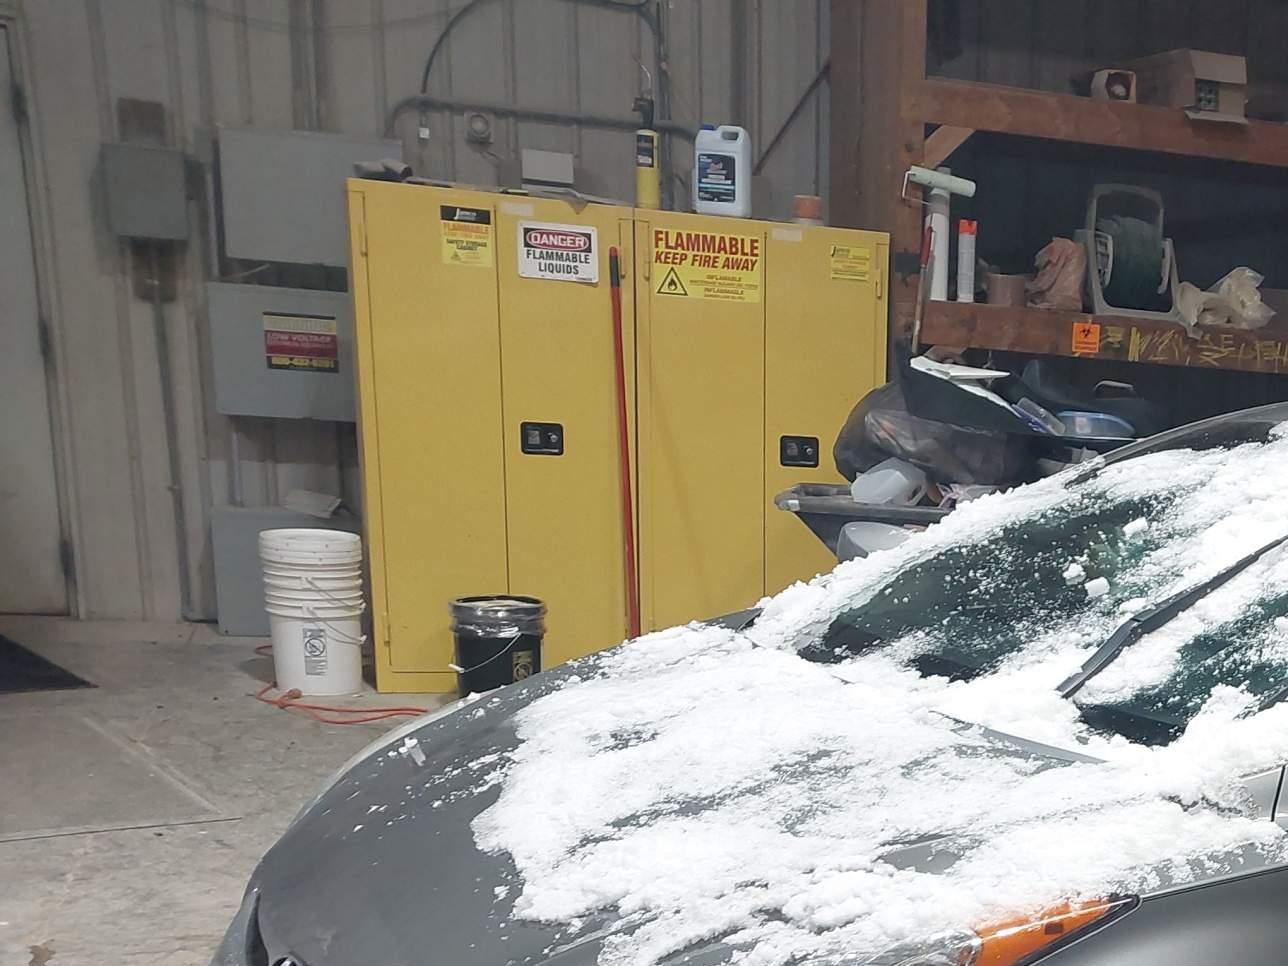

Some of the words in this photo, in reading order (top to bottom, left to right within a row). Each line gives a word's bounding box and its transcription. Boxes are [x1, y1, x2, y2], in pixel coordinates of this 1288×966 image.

[530, 232, 586, 249] DANGER
[654, 230, 760, 257] FLAMMABLE
[526, 249, 591, 265] FLAMMABLE
[654, 250, 687, 266] KEEP
[691, 253, 719, 269] FIRE
[722, 256, 758, 272] AWAY
[538, 261, 580, 276] LIQUIDS
